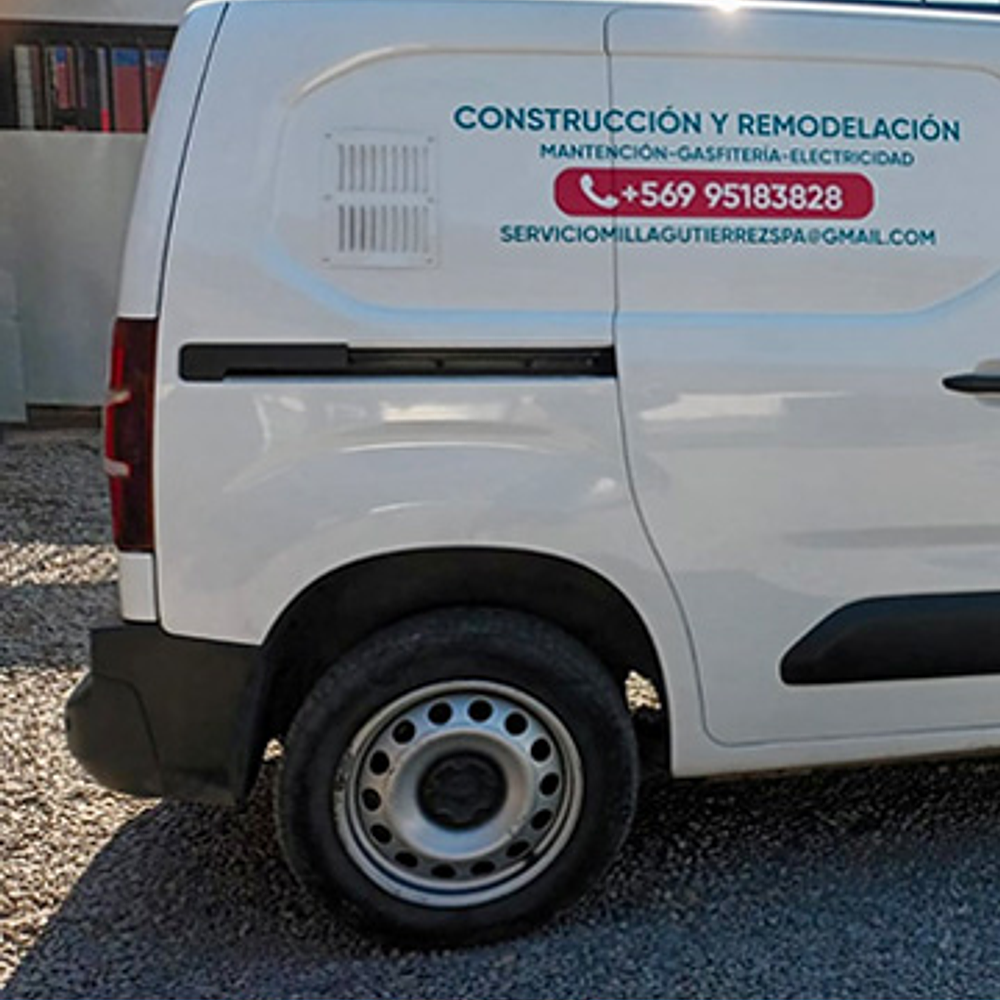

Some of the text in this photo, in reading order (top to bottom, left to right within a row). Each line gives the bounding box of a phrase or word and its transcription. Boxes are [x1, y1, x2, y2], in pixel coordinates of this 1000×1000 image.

[453, 105, 961, 142] CONSTRUCCIÓN Y REMODELACIÓN
[621, 182, 844, 211] +569 95183828
[499, 224, 937, 246] SERVICIOMILLAGUTIERREZSPA@GMAIL.COM
